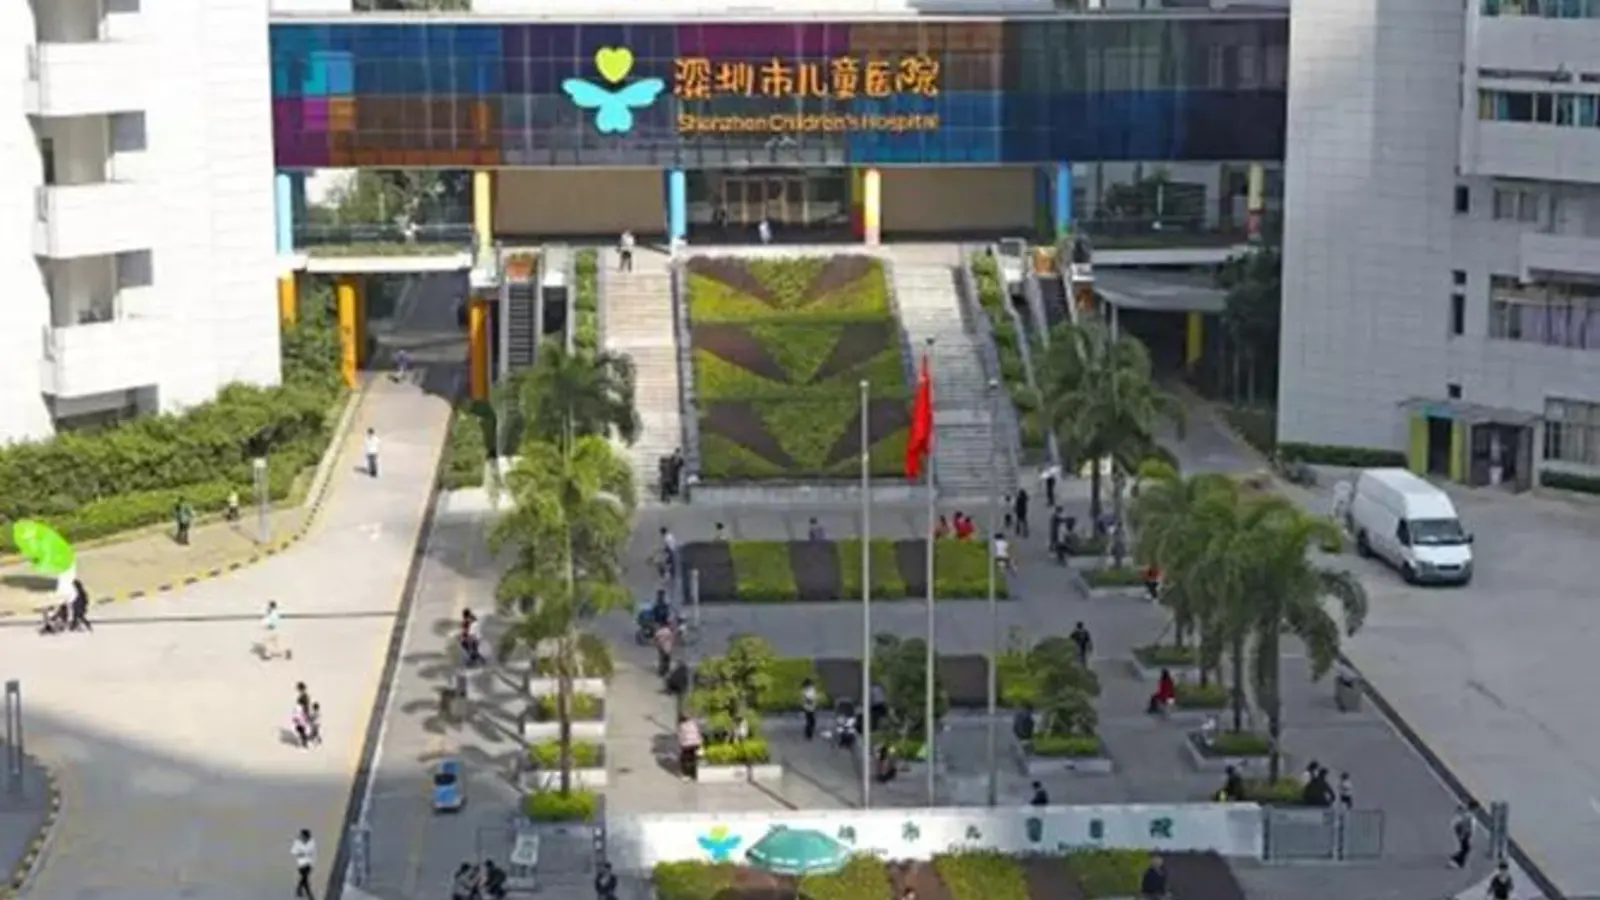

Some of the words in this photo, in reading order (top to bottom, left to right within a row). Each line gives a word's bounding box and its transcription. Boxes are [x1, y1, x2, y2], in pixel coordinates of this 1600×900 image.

[674, 56, 940, 98] 深圳市儿童医院
[678, 113, 766, 132] Shenzhen
[862, 112, 939, 134] Hospital
